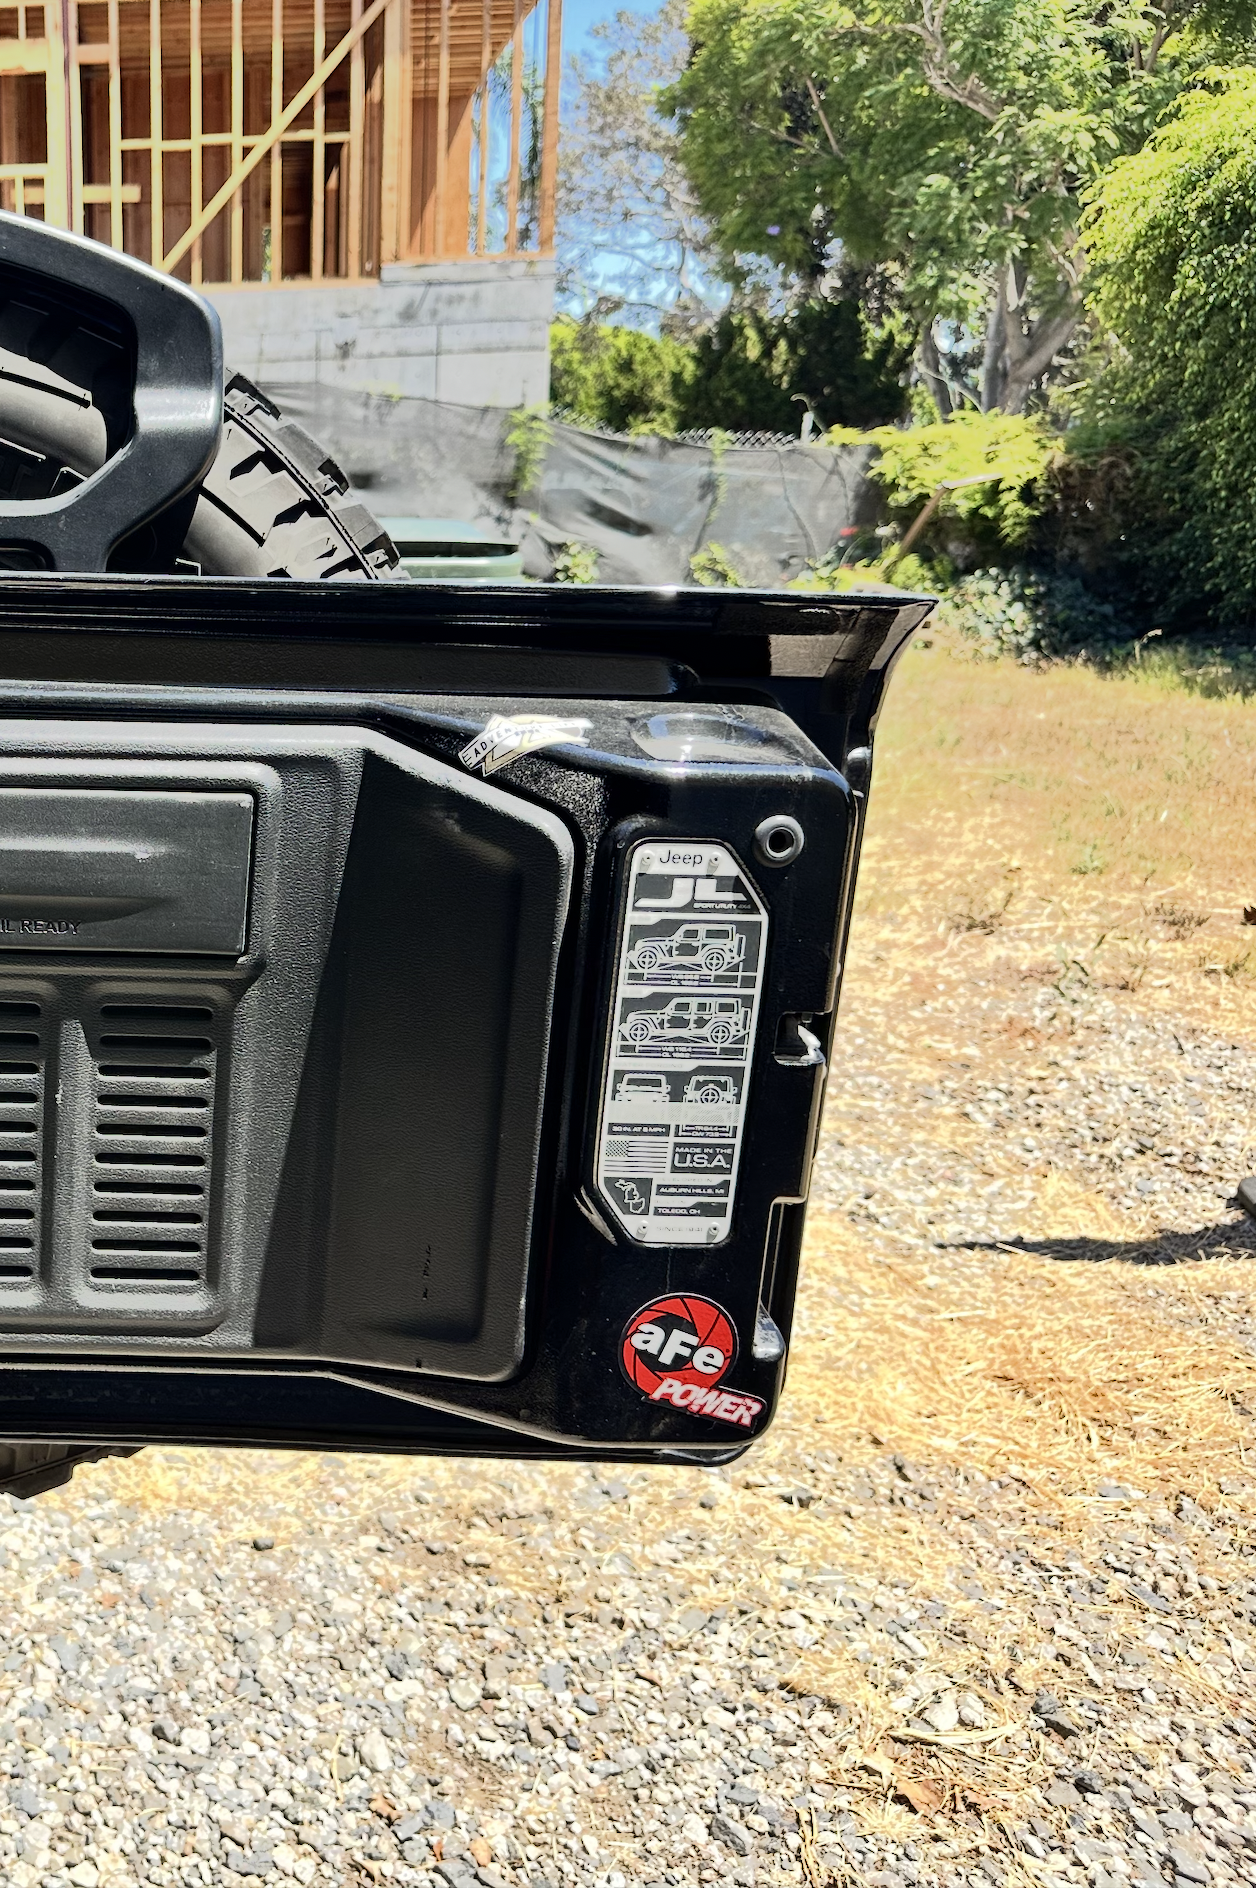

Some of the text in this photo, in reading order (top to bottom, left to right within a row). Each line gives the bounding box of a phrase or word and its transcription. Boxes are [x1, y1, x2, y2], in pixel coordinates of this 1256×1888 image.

[659, 850, 703, 867] Jeep
[634, 877, 747, 908] JL
[19, 919, 82, 936] READY
[673, 1154, 731, 1169] U.S.A.
[630, 1322, 725, 1375] aFe
[649, 1377, 763, 1428] POWER
